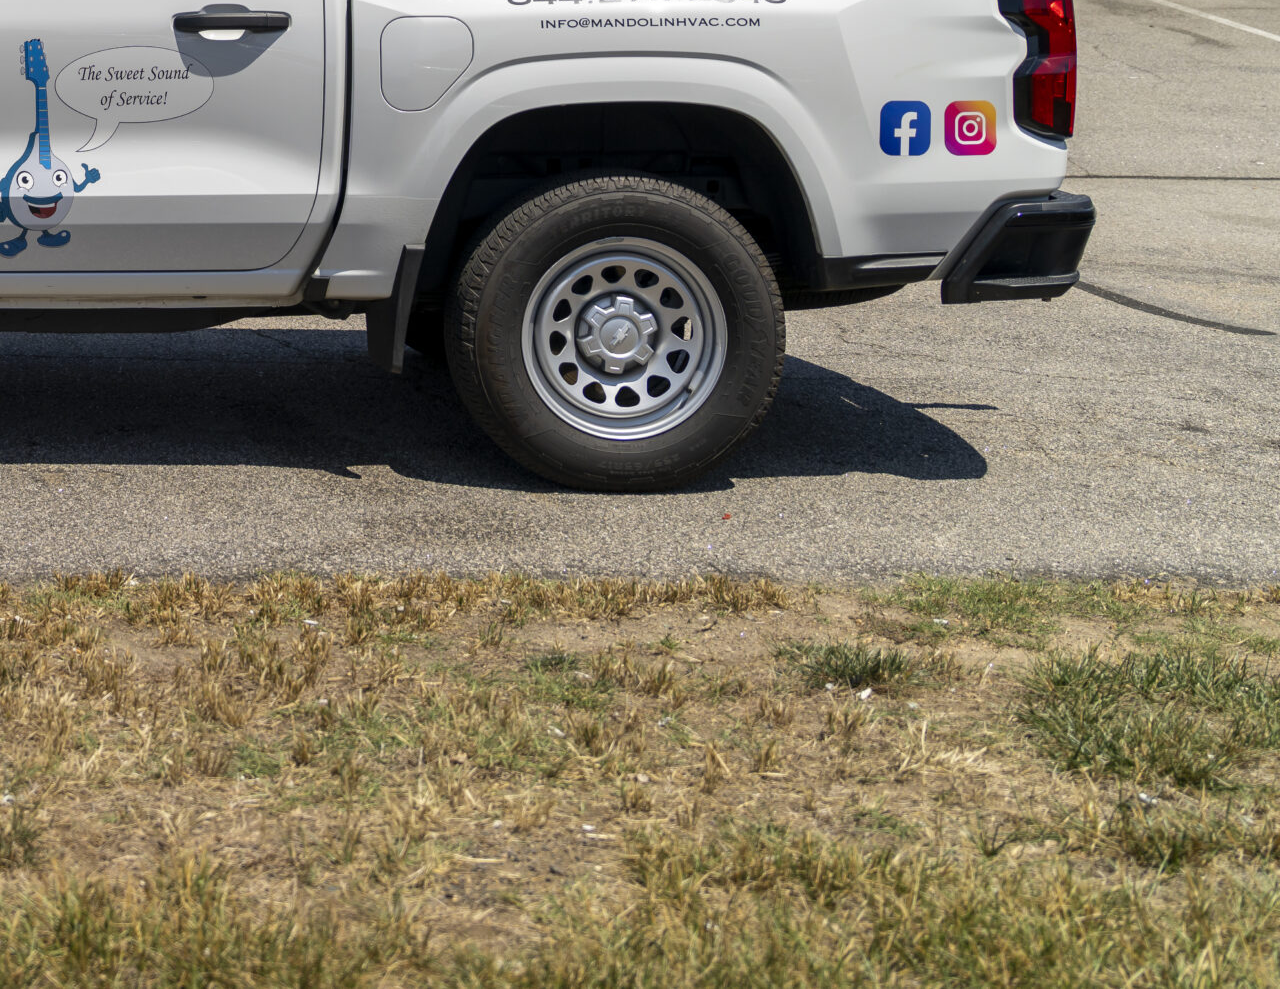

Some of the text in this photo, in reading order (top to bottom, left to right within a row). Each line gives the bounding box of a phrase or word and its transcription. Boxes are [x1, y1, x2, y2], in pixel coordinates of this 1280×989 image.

[78, 63, 193, 82] The Sweet Sound
[100, 90, 168, 110] of Service!
